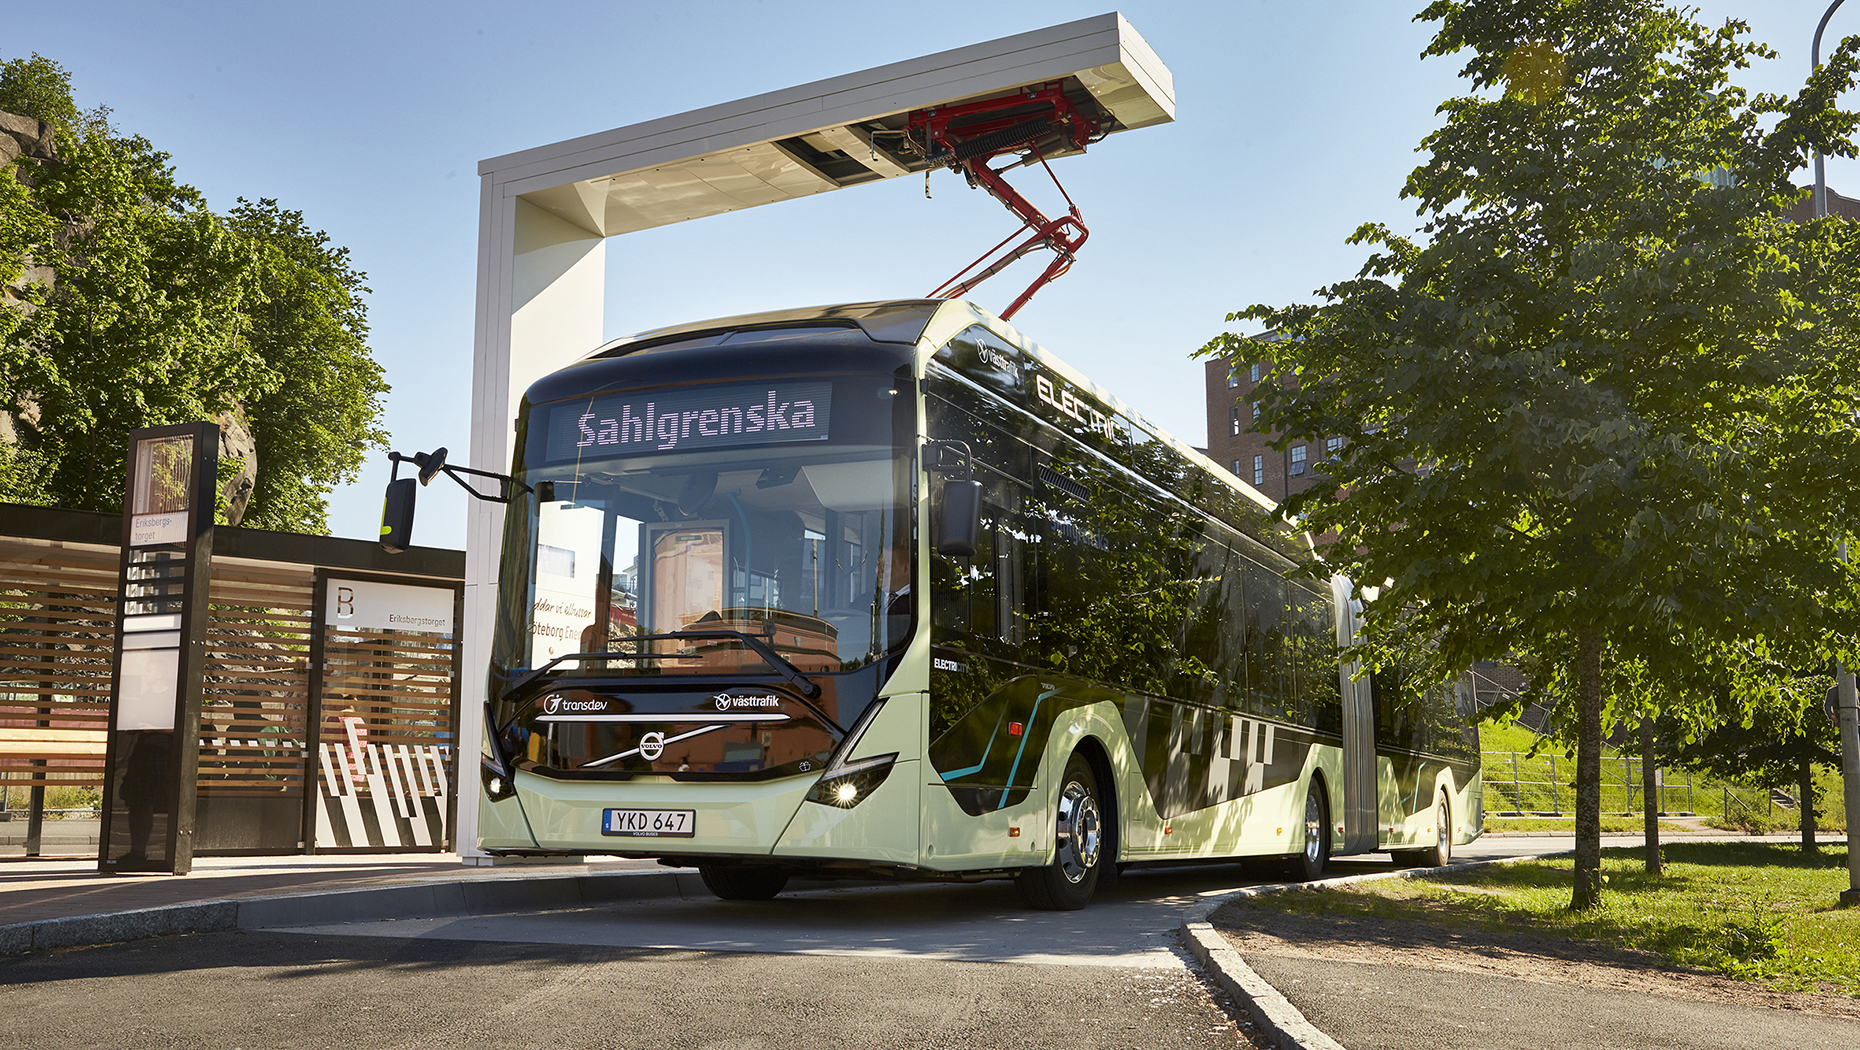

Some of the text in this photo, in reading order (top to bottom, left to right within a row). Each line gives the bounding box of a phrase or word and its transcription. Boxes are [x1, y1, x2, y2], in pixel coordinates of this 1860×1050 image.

[1036, 374, 1123, 446] ELECTRIC
[577, 391, 816, 450] Sahlgrenska
[135, 518, 172, 528] Eriksbergs-
[135, 531, 155, 542] torget
[337, 586, 354, 619] B
[556, 602, 563, 614] vi
[564, 603, 592, 618] elbussar
[389, 614, 446, 627] Eriksbergstorget
[532, 621, 581, 641] öteborg Ener
[934, 657, 969, 674] ELECTRICITY
[562, 699, 608, 711] transdev
[732, 695, 779, 708] västtrafik
[617, 812, 686, 831] YKD 647
